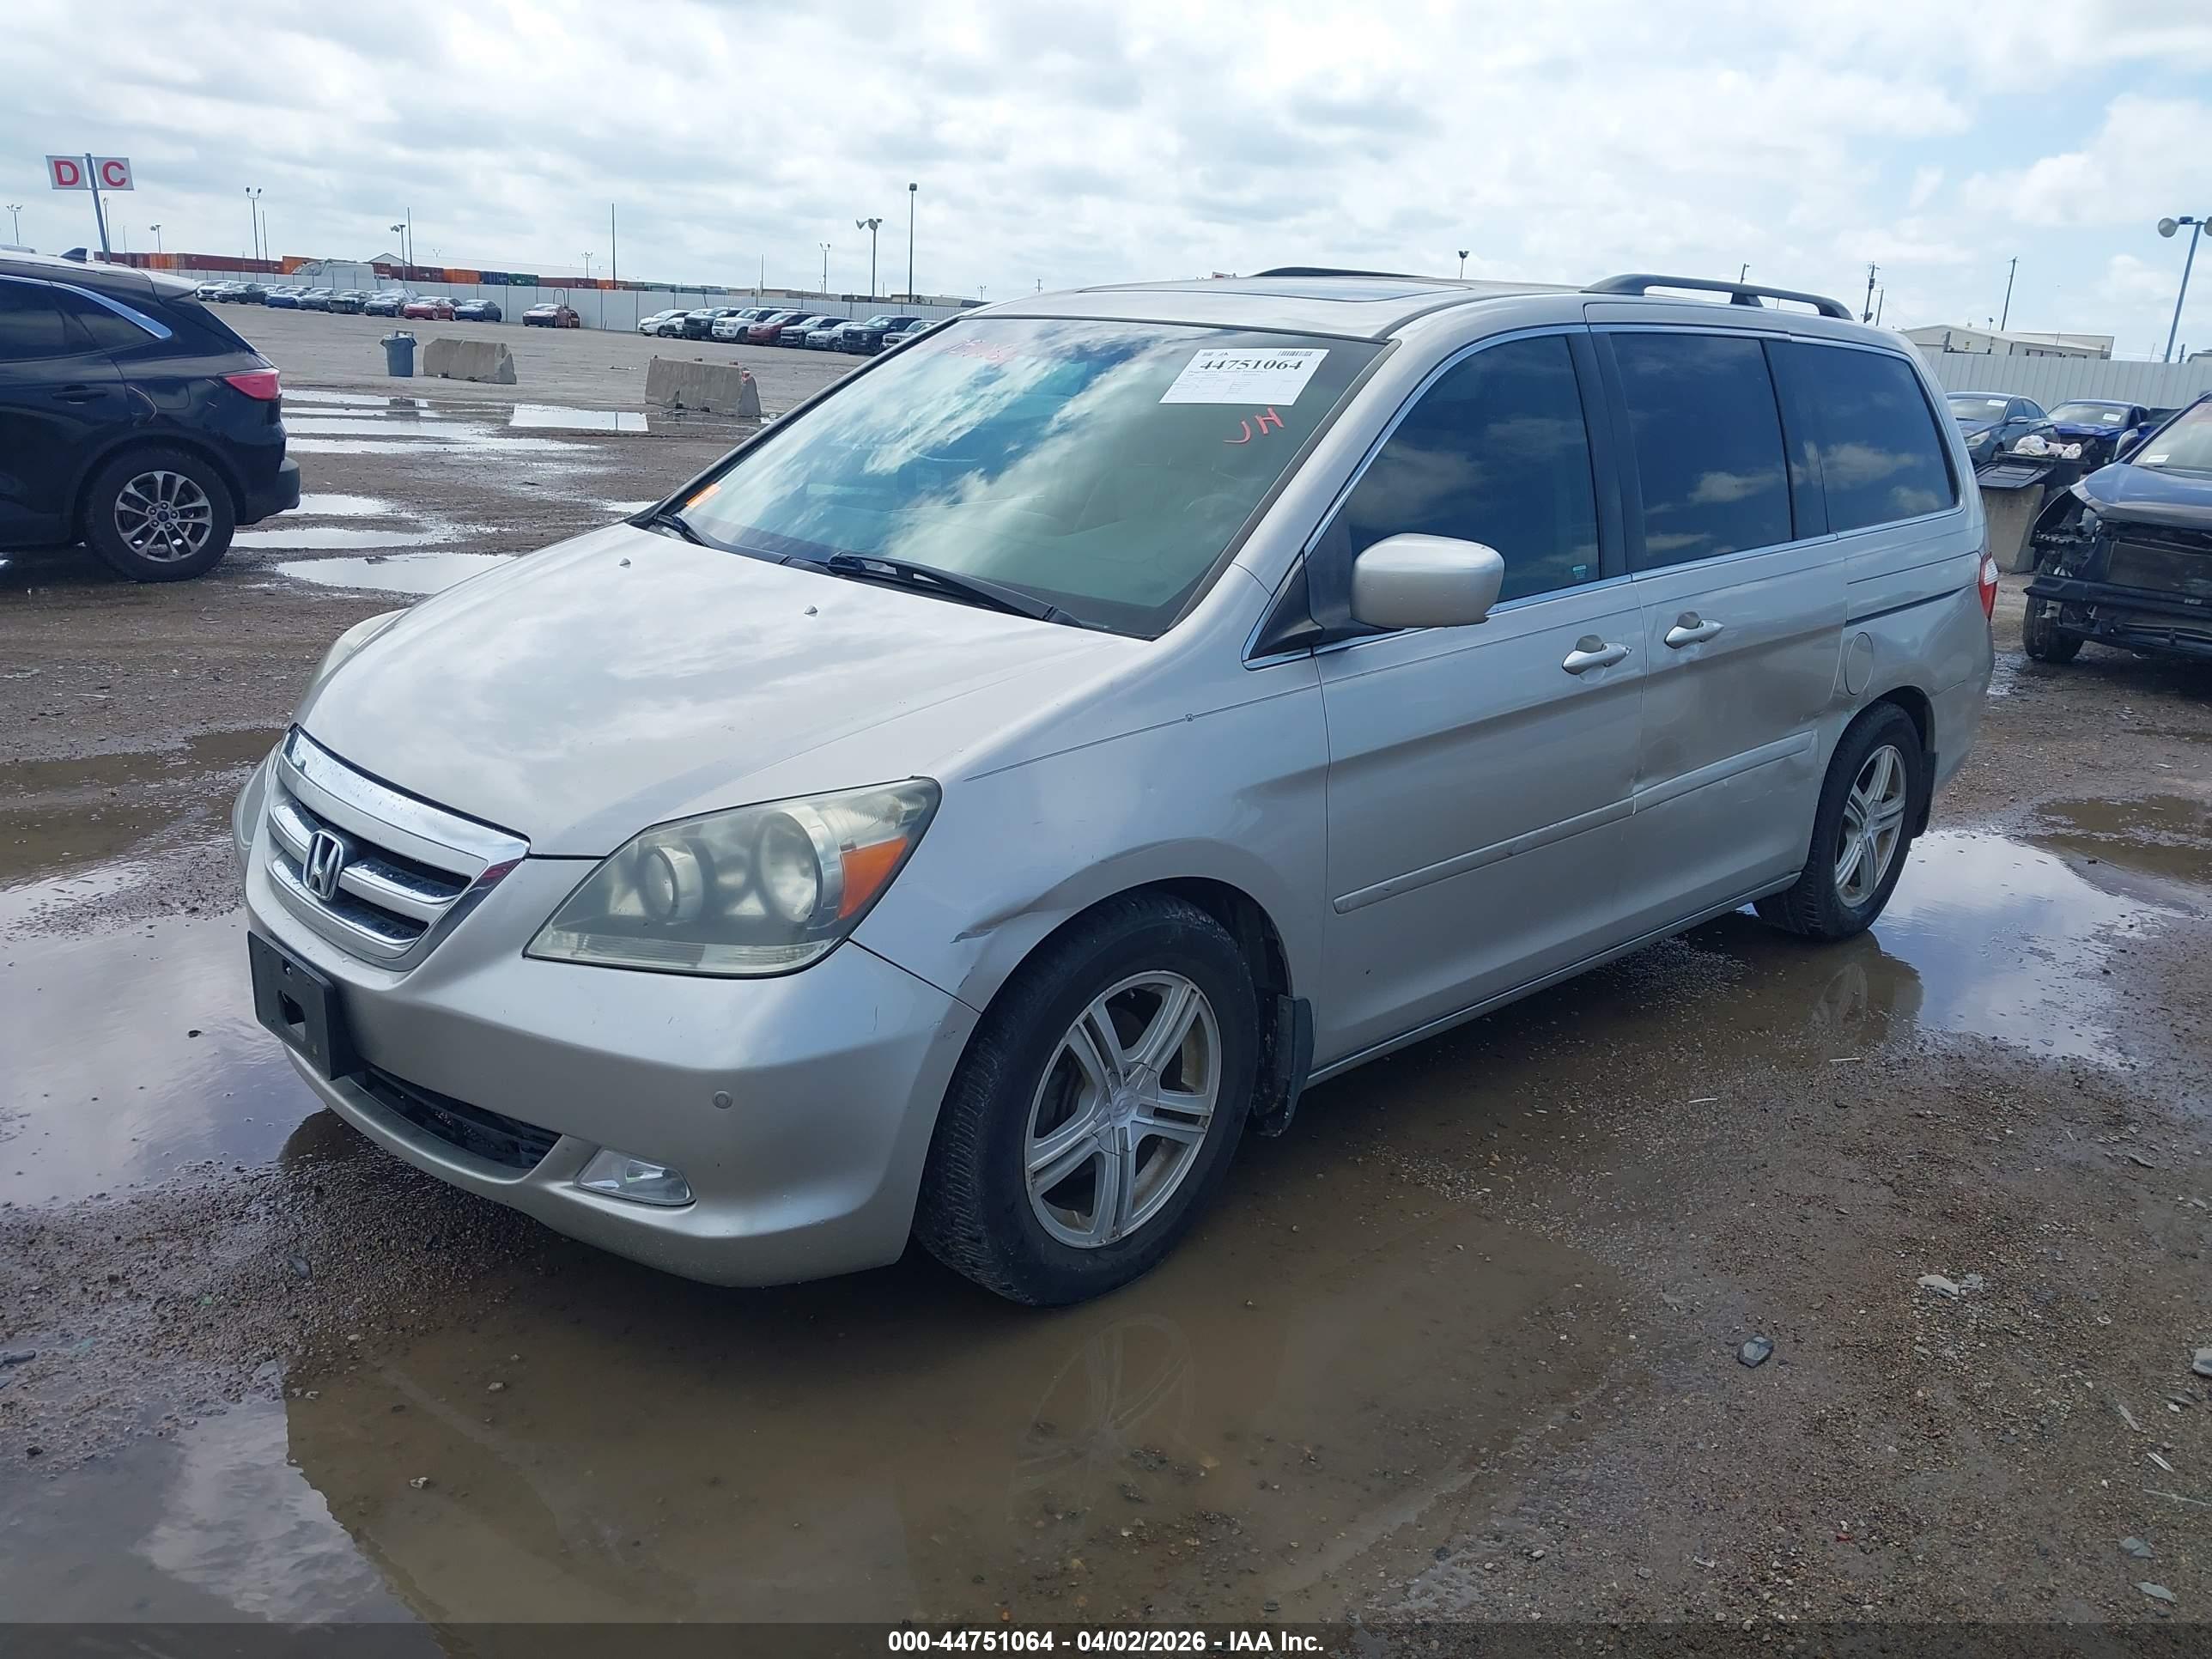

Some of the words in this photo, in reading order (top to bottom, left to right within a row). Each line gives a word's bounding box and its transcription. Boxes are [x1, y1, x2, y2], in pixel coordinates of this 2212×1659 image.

[53, 161, 79, 185] D
[102, 161, 126, 186] C
[1199, 359, 1304, 370] 44751064
